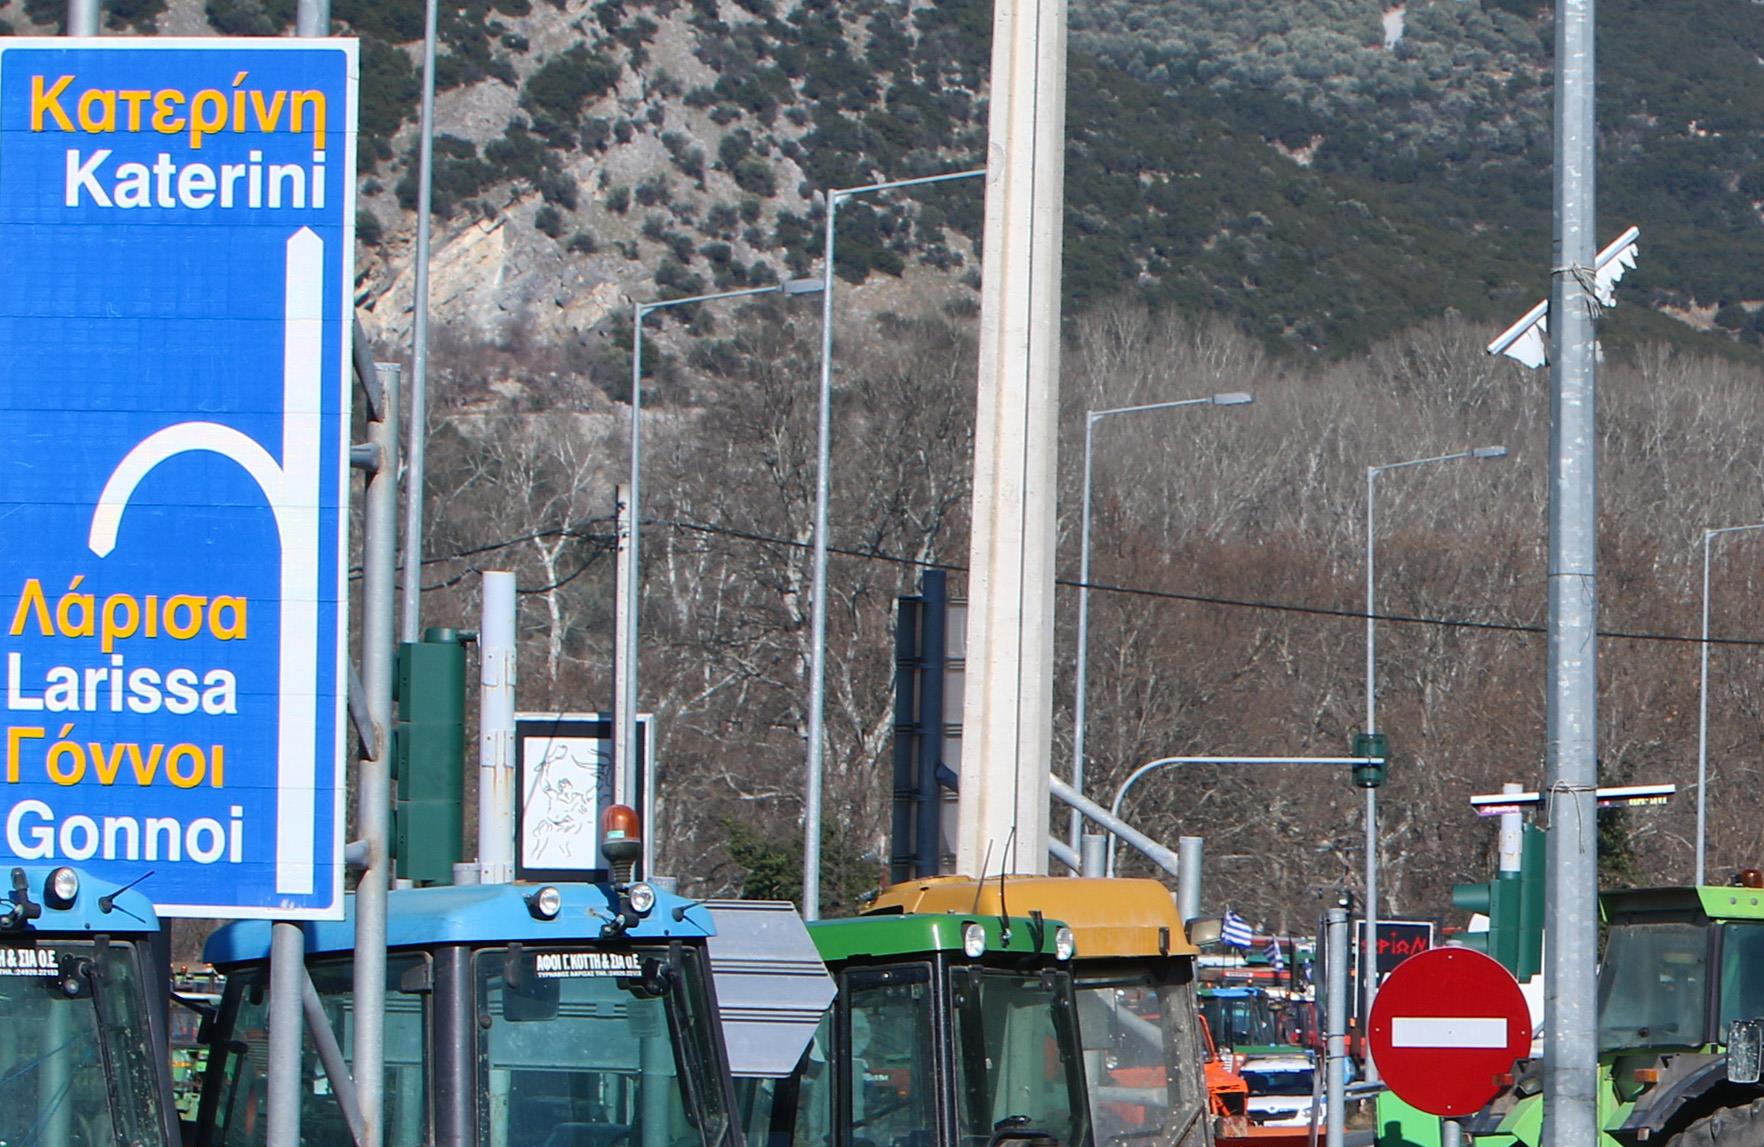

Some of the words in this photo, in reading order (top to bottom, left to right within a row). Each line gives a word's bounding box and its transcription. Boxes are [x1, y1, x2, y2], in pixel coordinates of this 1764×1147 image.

[30, 71, 327, 149] Κατερίνη
[65, 149, 326, 209] Katerini
[8, 575, 248, 654] Λάρισα
[7, 652, 238, 715] Larissa
[6, 723, 224, 788] Γόννοι
[6, 799, 244, 864] Gonnoi
